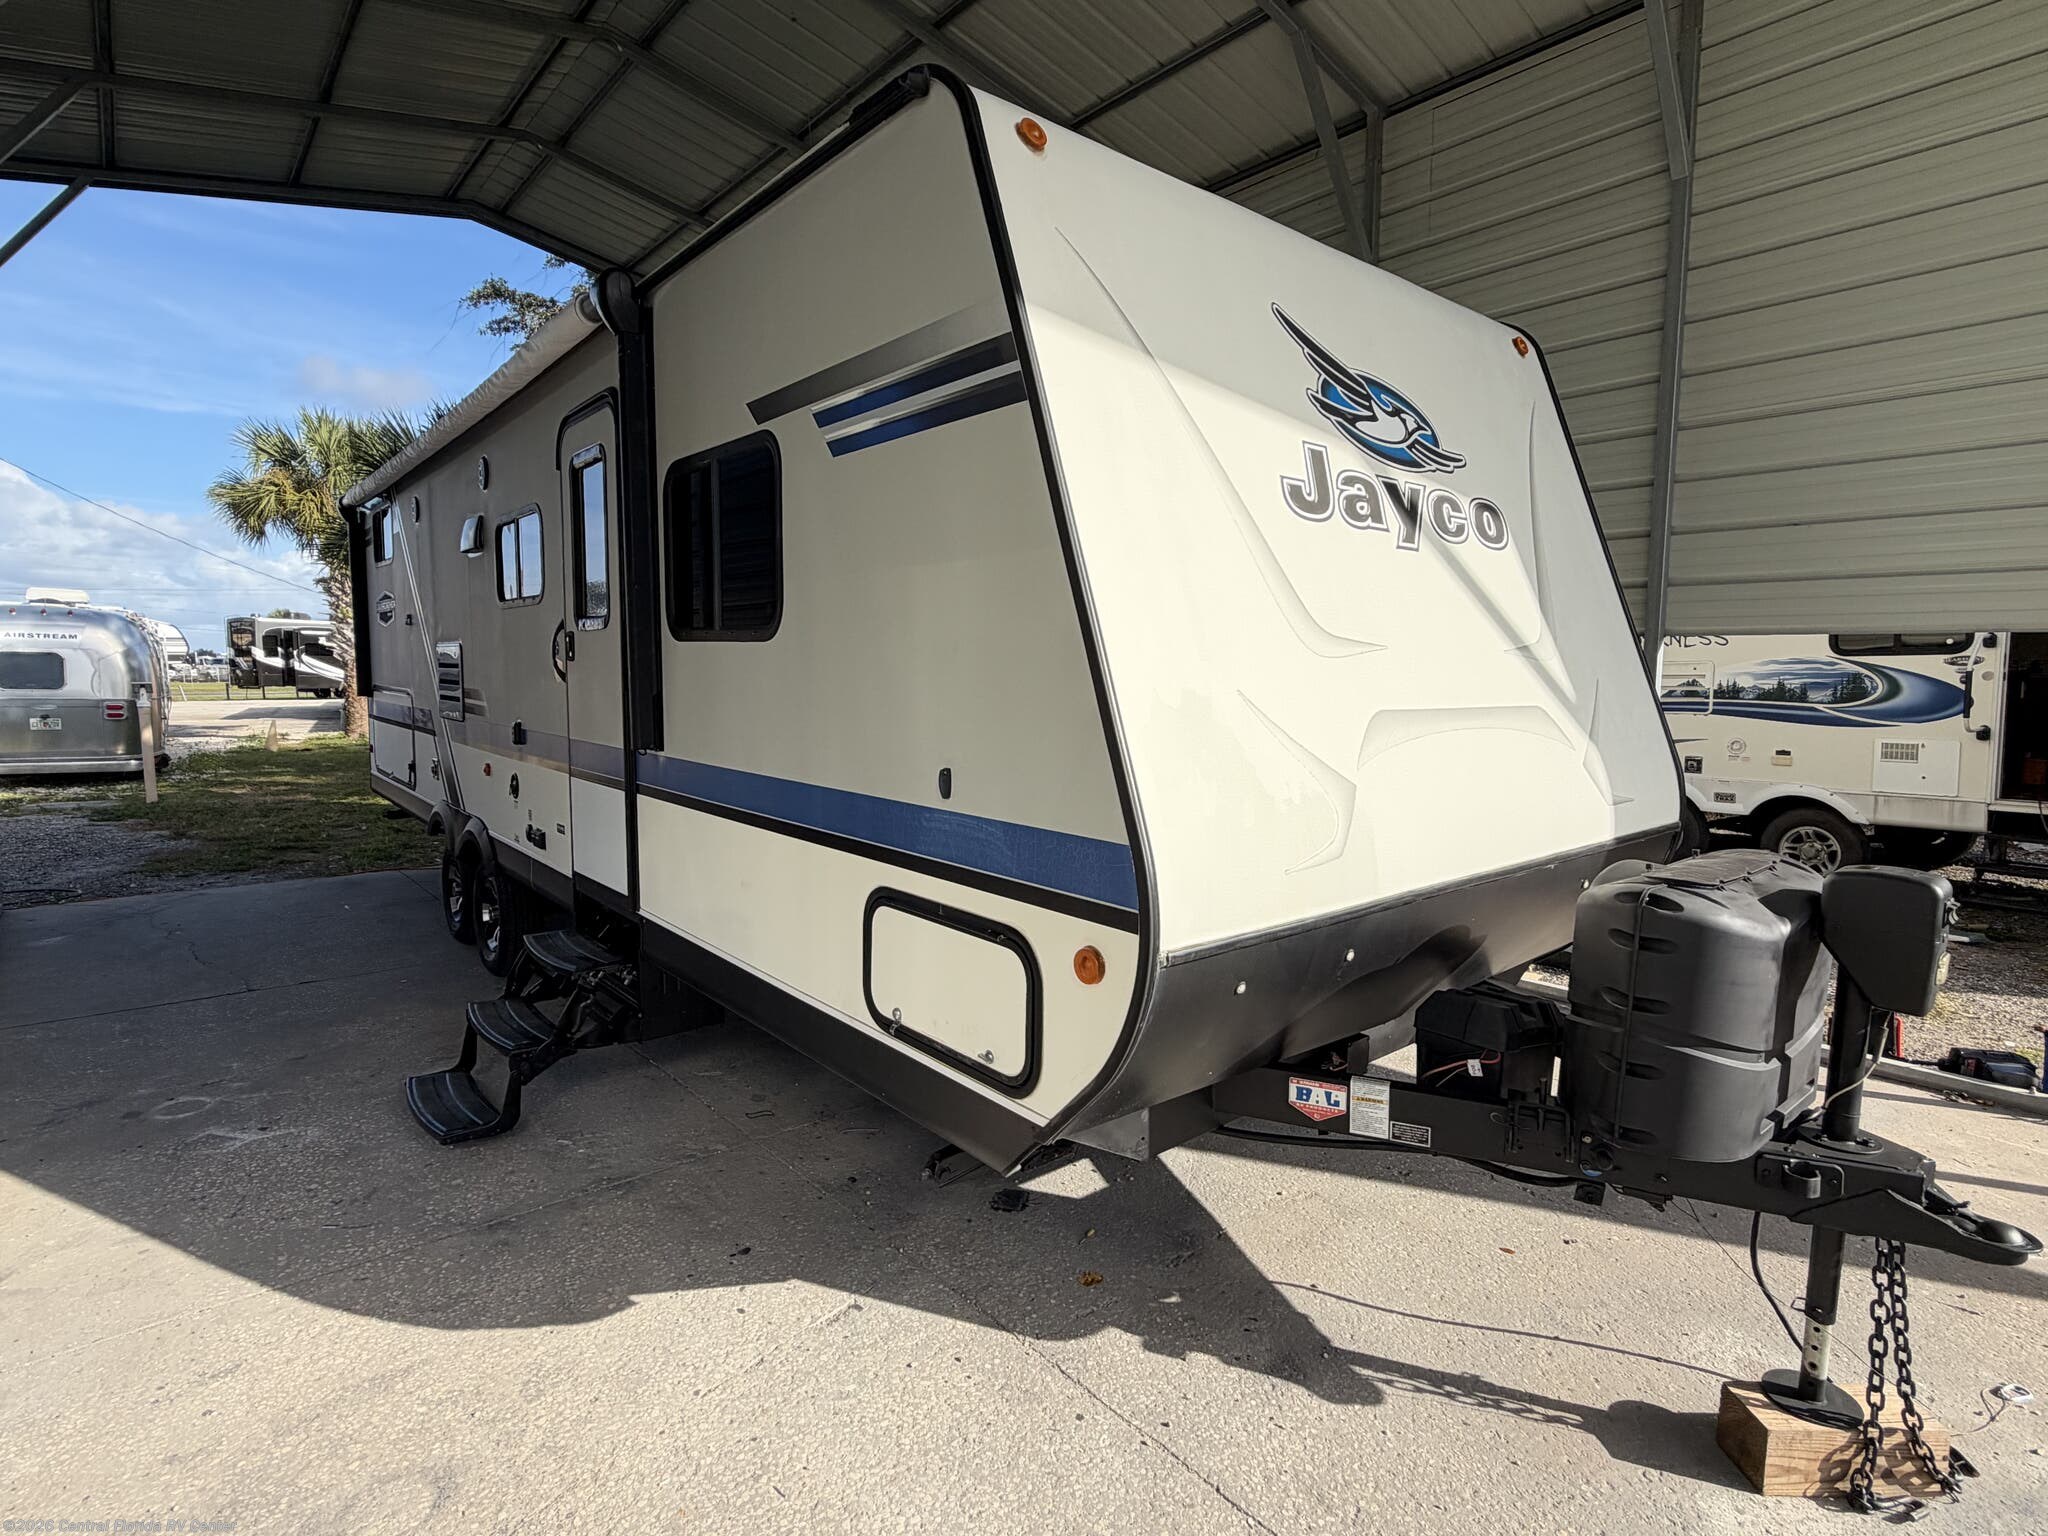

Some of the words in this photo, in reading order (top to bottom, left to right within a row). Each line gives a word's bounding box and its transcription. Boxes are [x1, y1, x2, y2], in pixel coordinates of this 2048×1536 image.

[1280, 440, 1510, 552] Jayco
[4, 632, 78, 640] AIRSTREAM
[1664, 635, 1729, 648] NESS
[1295, 1085, 1340, 1108] BAL
